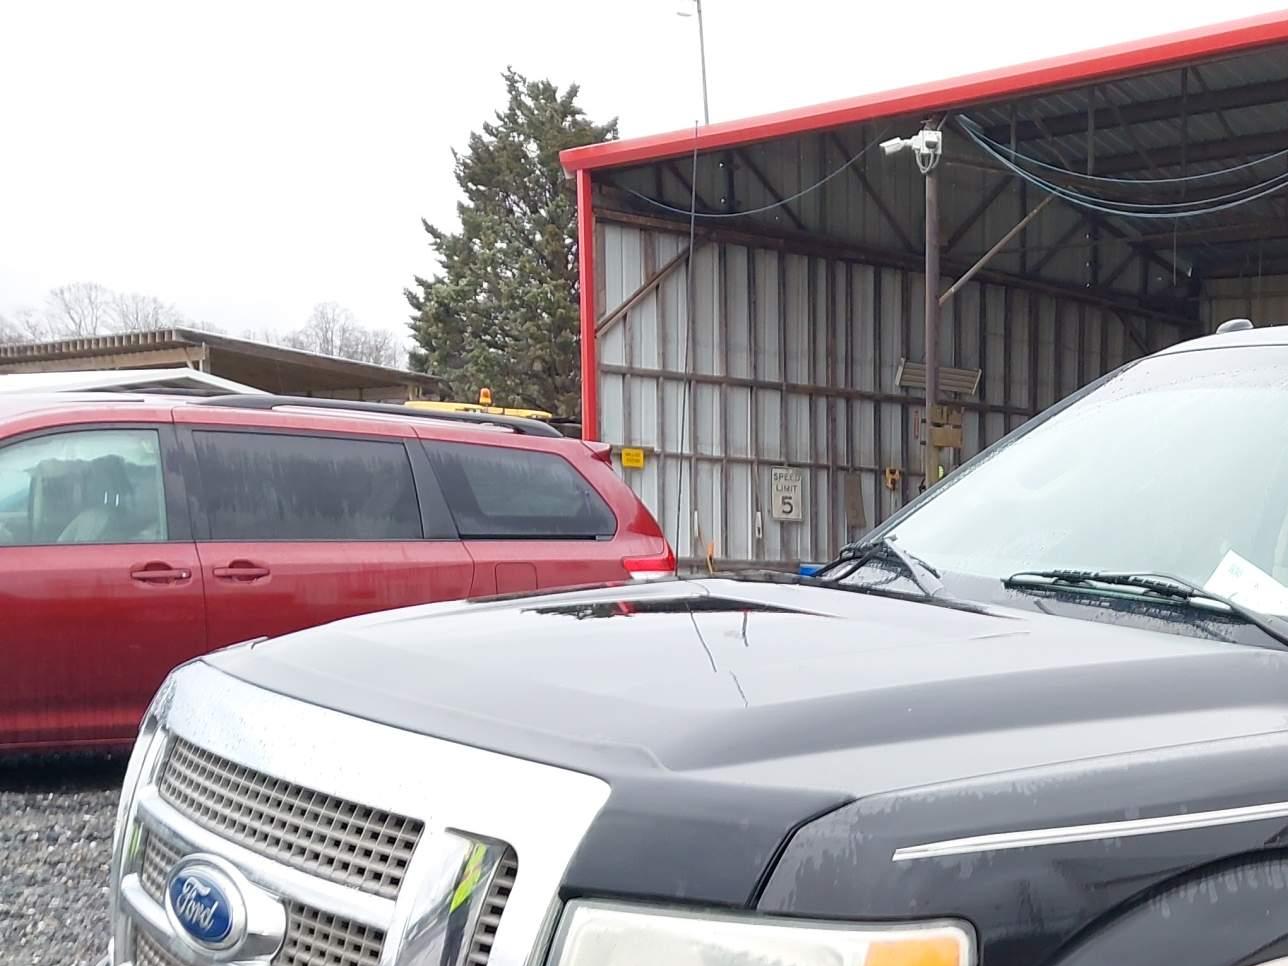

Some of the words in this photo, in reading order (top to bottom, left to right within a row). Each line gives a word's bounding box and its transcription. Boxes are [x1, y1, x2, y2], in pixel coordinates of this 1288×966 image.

[773, 472, 801, 481] SPEED
[776, 484, 799, 493] LIMIT
[781, 495, 793, 514] 5
[177, 876, 219, 931] Ford
